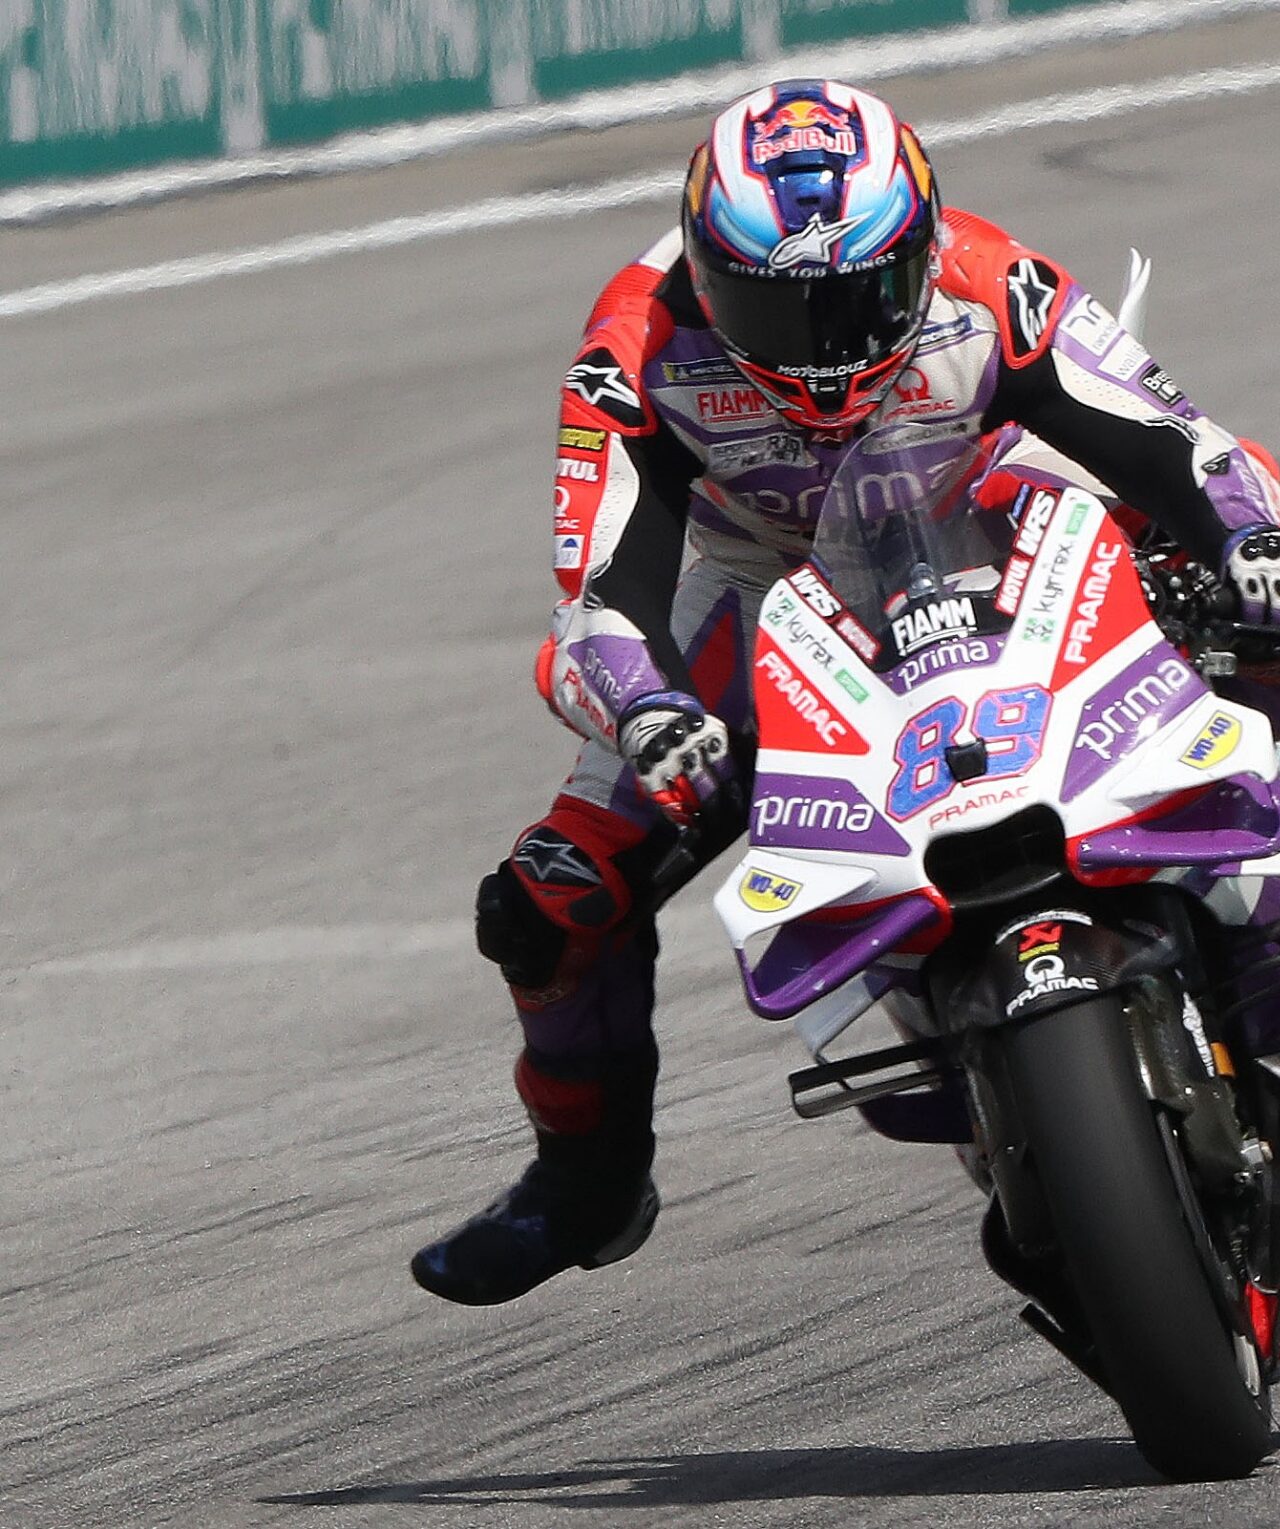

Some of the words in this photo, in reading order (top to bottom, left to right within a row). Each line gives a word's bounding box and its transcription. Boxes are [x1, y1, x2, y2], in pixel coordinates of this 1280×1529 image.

[752, 131, 801, 163] Red
[802, 128, 857, 155] Bull
[728, 261, 776, 278] GIVES
[788, 266, 828, 279] YOU
[836, 252, 896, 274] WINGS
[557, 459, 599, 482] TUL
[1063, 542, 1122, 664] PRAMAC
[891, 597, 976, 657] FIAMM
[898, 638, 989, 690] prima
[755, 650, 847, 747] PRAMAC
[1075, 659, 1191, 760] prima
[885, 683, 1054, 823] 89
[1187, 717, 1232, 763] WD-40
[753, 796, 875, 837] prima
[928, 785, 1030, 829] PRAMAC
[747, 872, 796, 901] WD-40
[1006, 977, 1099, 1017] PRAMAC
